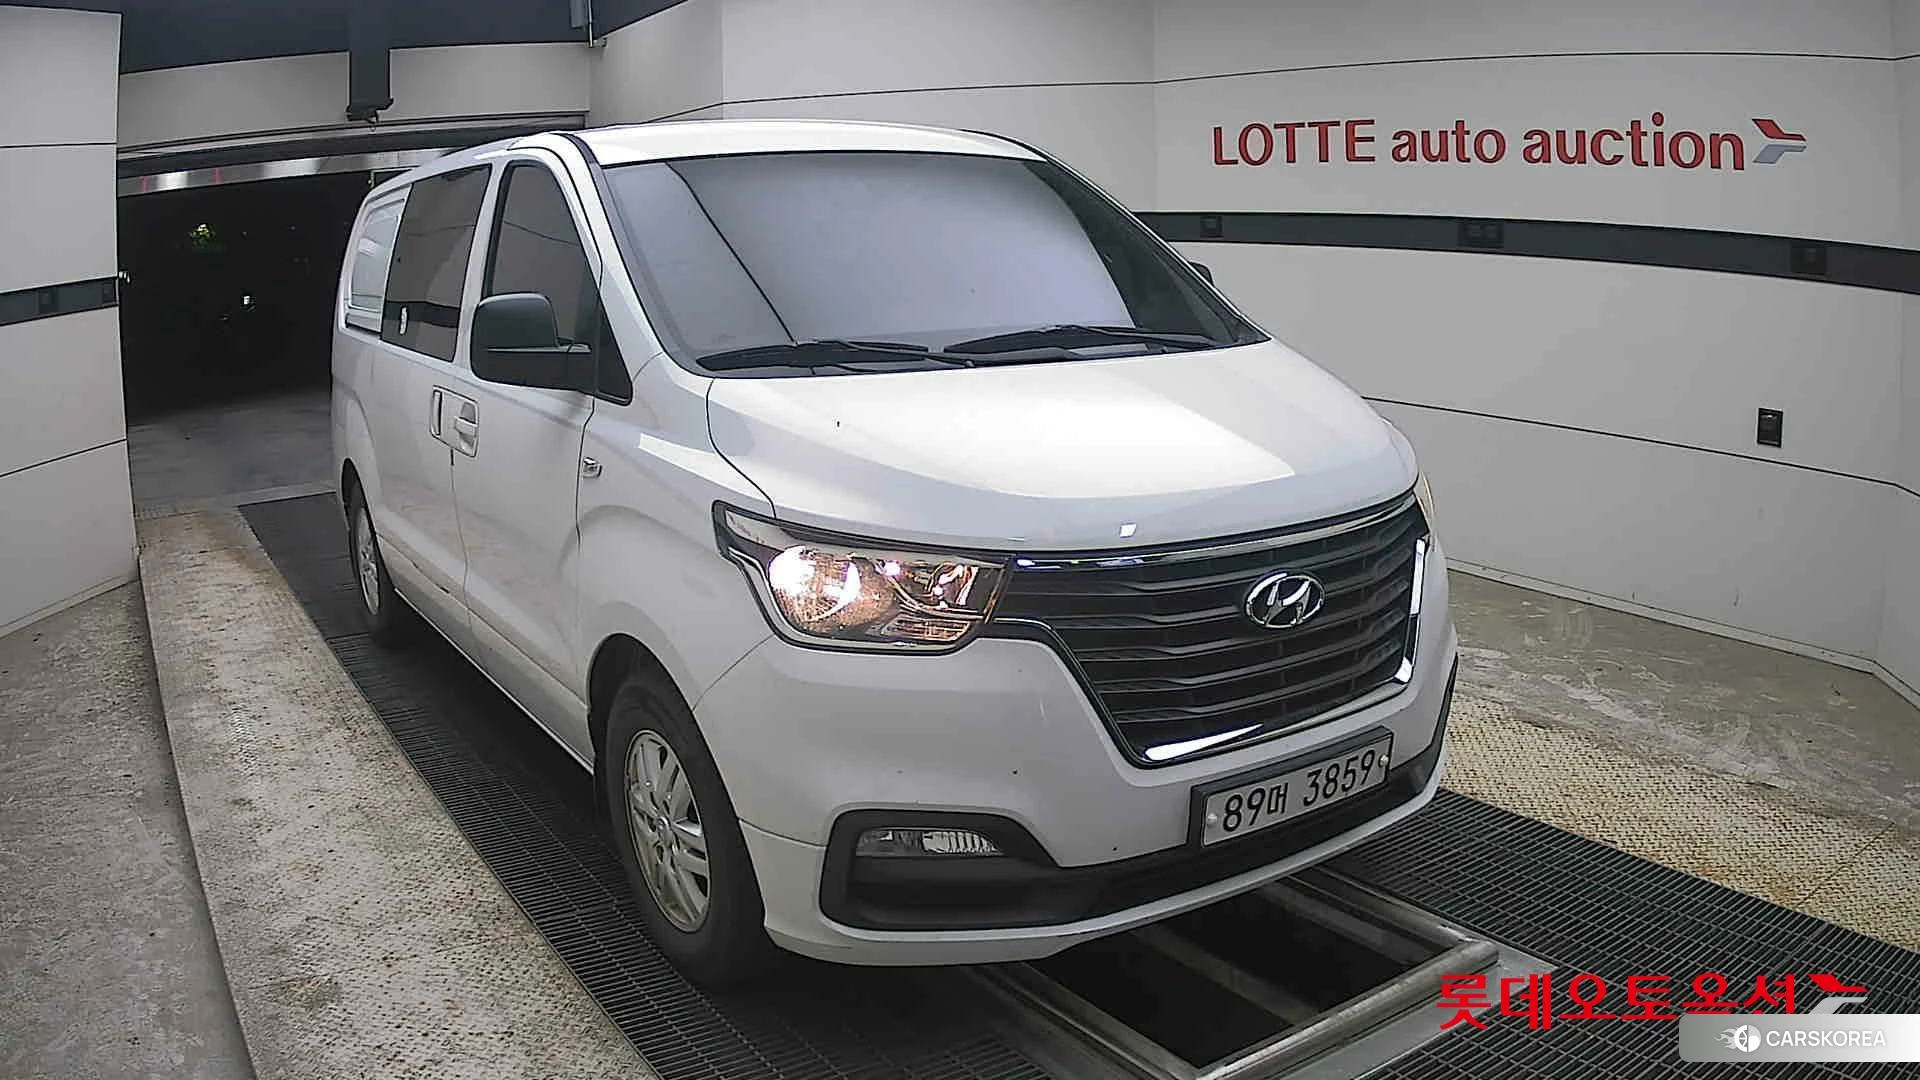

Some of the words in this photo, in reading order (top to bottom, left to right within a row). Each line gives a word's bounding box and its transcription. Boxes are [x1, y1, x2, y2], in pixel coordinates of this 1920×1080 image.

[1212, 119, 1376, 166] LOTTE
[1391, 120, 1507, 163] auto
[1522, 112, 1745, 171] auction
[1222, 782, 1289, 832] 89머
[1303, 749, 1376, 807] 3859
